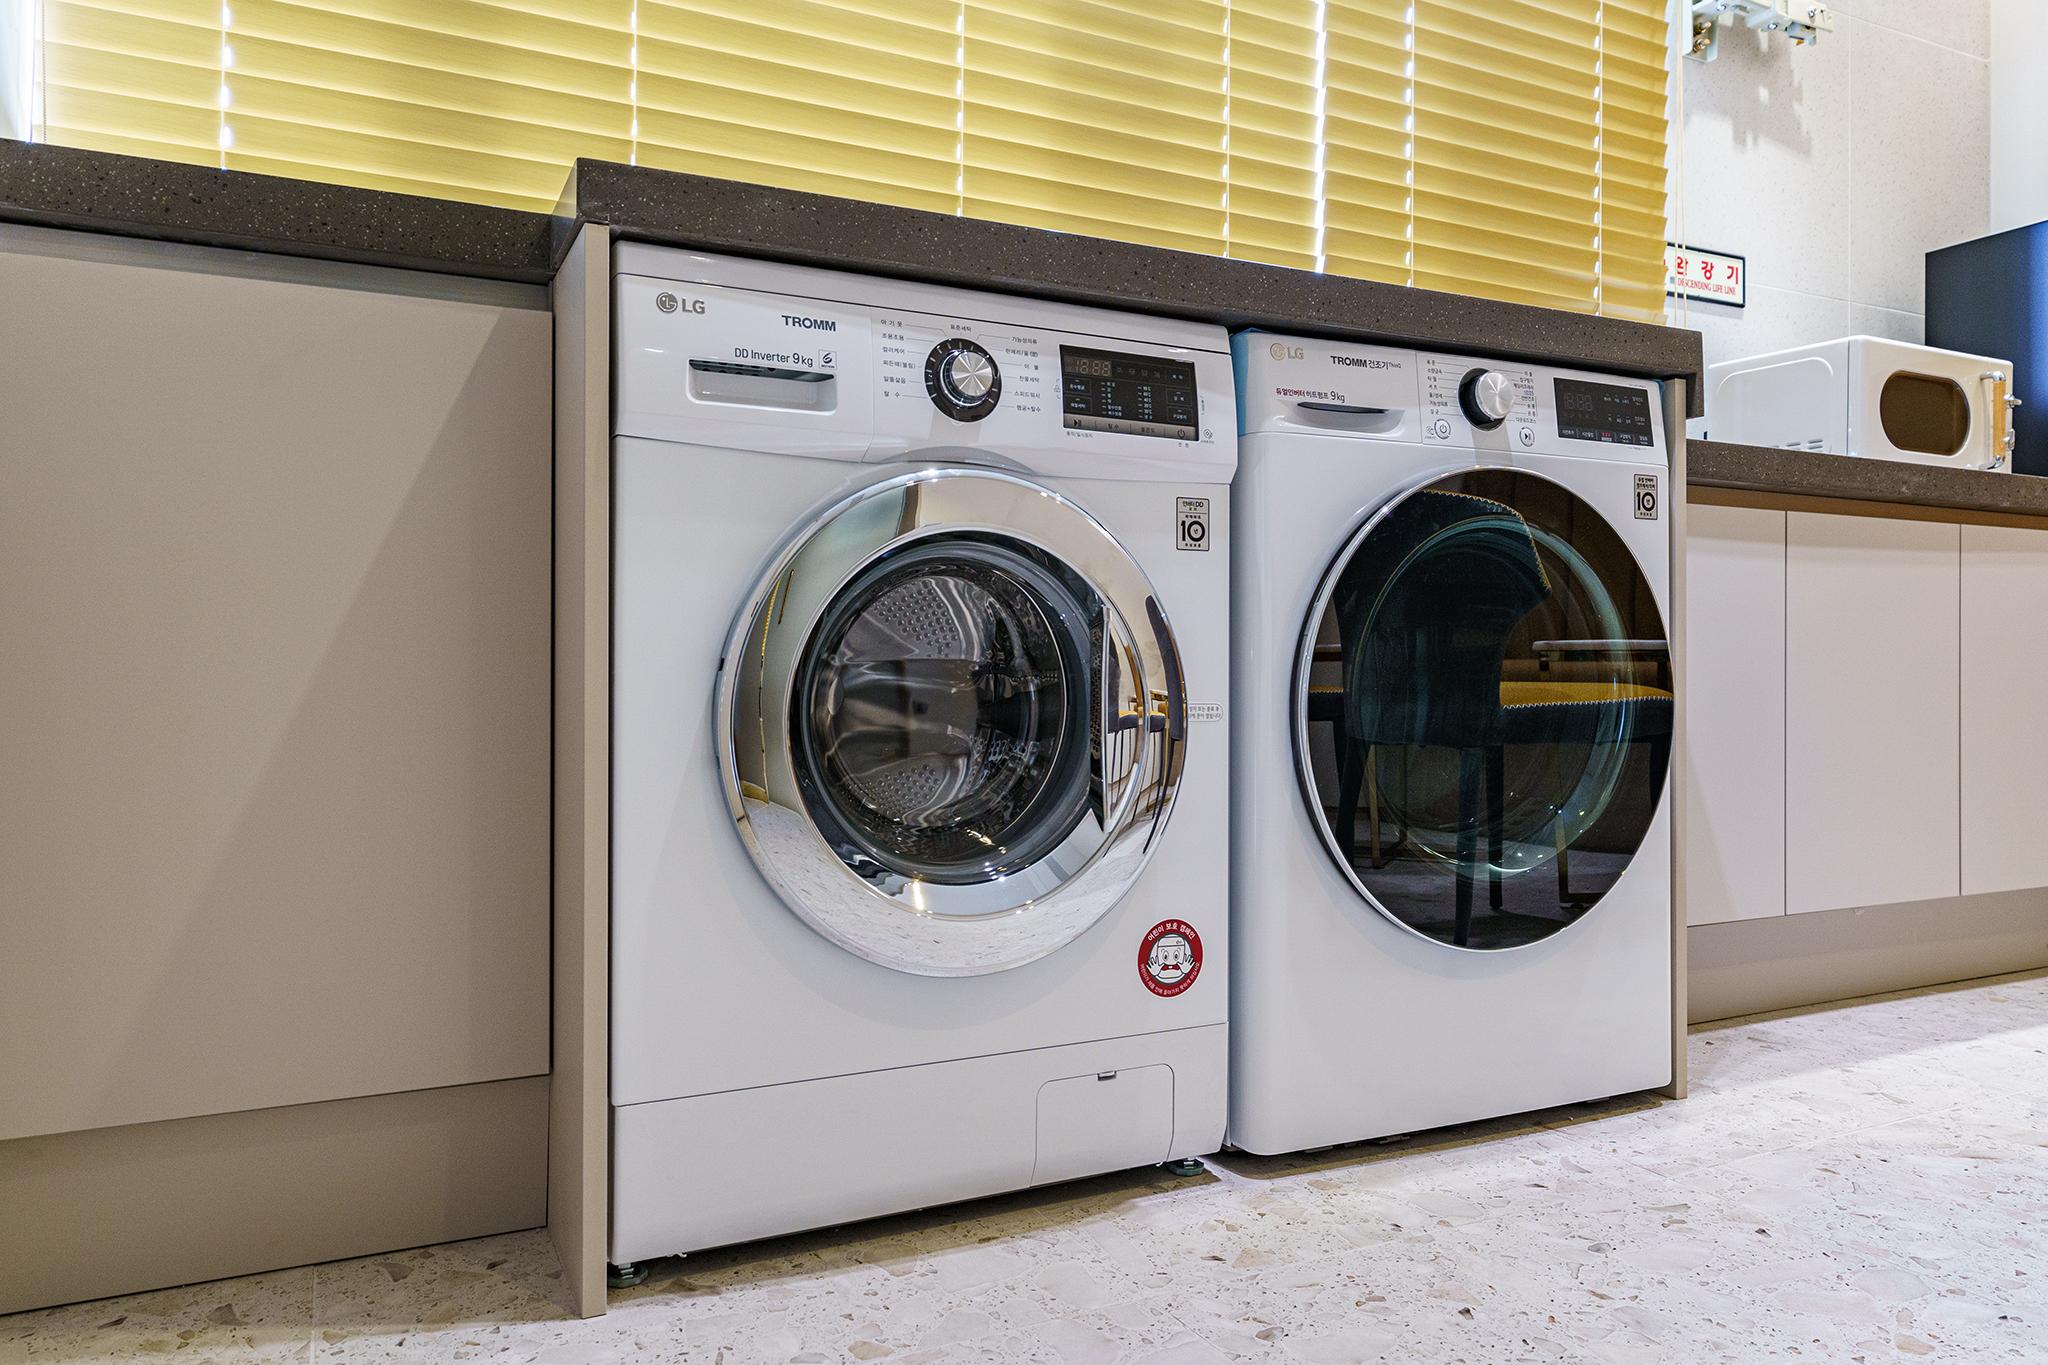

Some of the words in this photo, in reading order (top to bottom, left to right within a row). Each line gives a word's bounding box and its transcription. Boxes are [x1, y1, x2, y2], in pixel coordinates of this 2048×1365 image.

[681, 298, 706, 314] LG
[781, 314, 837, 332] TROMM
[734, 347, 749, 359] DD
[751, 349, 790, 364] Inverter
[1286, 346, 1304, 360] LG
[1330, 355, 1367, 368] TROMM
[1367, 359, 1388, 370] 건조기
[1636, 491, 1655, 512] 10
[1181, 520, 1206, 542] 10
[1147, 924, 1165, 941] 어린이
[1165, 922, 1178, 931] 보호
